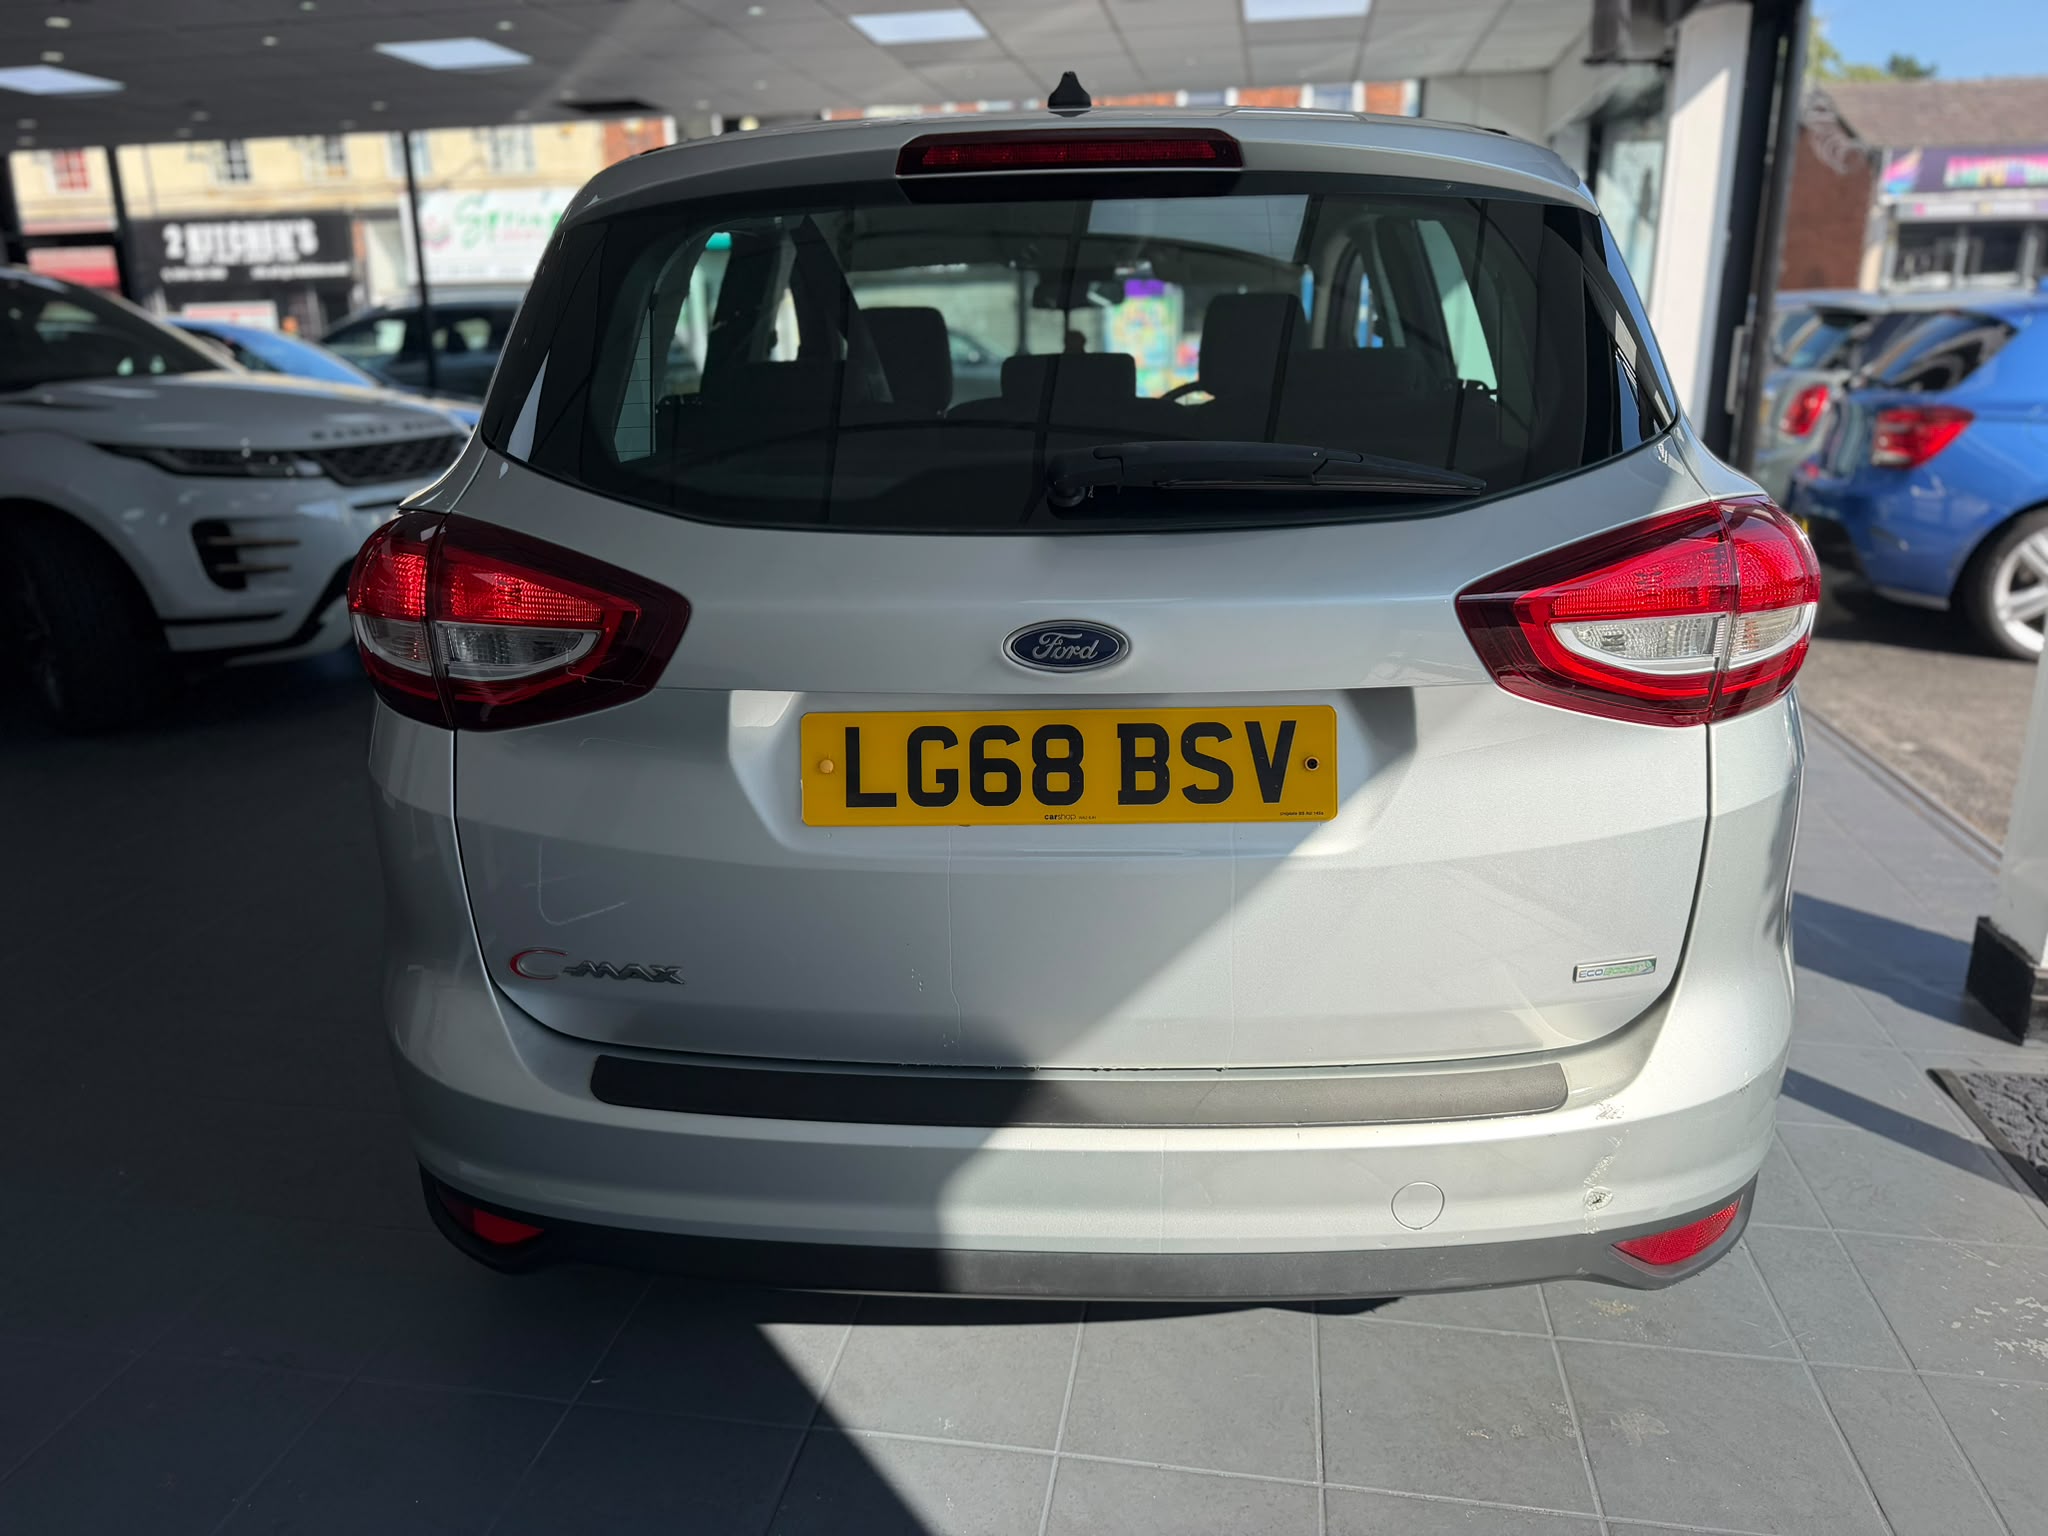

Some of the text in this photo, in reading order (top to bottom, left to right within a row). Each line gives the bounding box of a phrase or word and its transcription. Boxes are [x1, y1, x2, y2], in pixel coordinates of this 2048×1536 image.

[1032, 632, 1100, 660] Ford
[845, 720, 1297, 808] LG68 BSV
[1044, 813, 1077, 821] carshop
